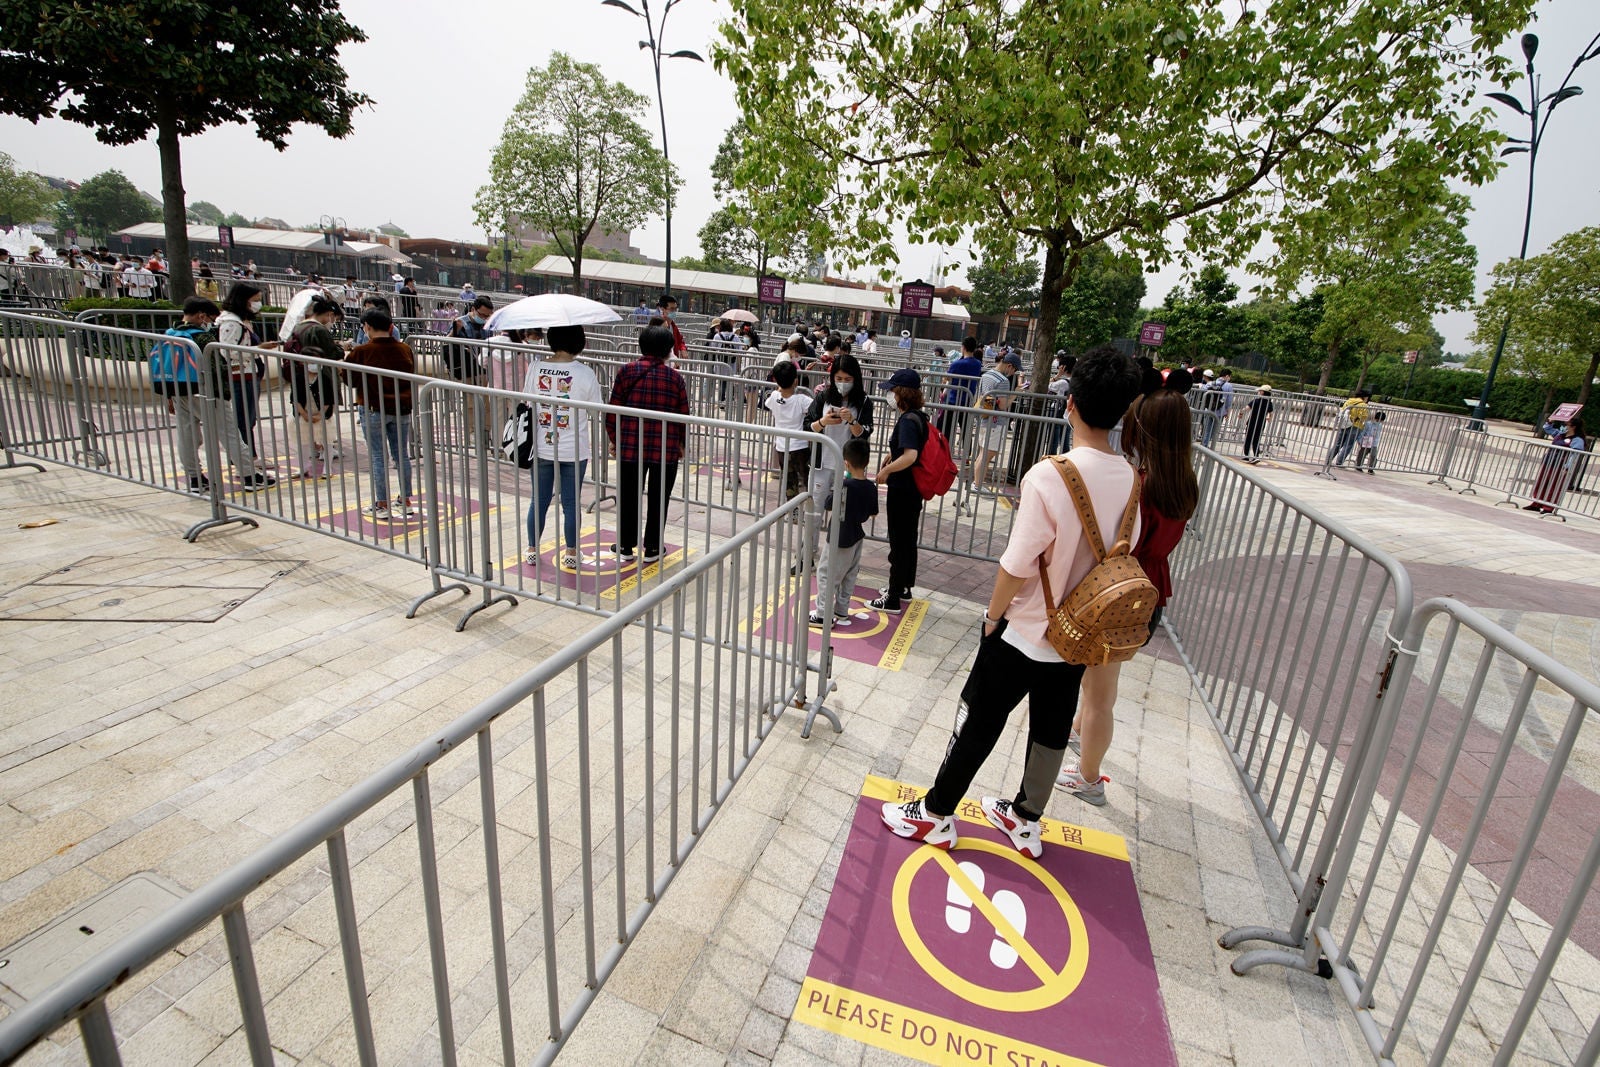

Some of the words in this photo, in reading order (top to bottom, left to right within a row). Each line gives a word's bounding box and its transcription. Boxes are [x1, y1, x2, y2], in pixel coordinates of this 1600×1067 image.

[539, 368, 570, 376] FEELING
[883, 645, 902, 668] PLEASE
[899, 625, 911, 639] NOT
[808, 990, 893, 1034] PLEASE
[901, 1019, 937, 1046] DO
[946, 1032, 998, 1066] NOT
